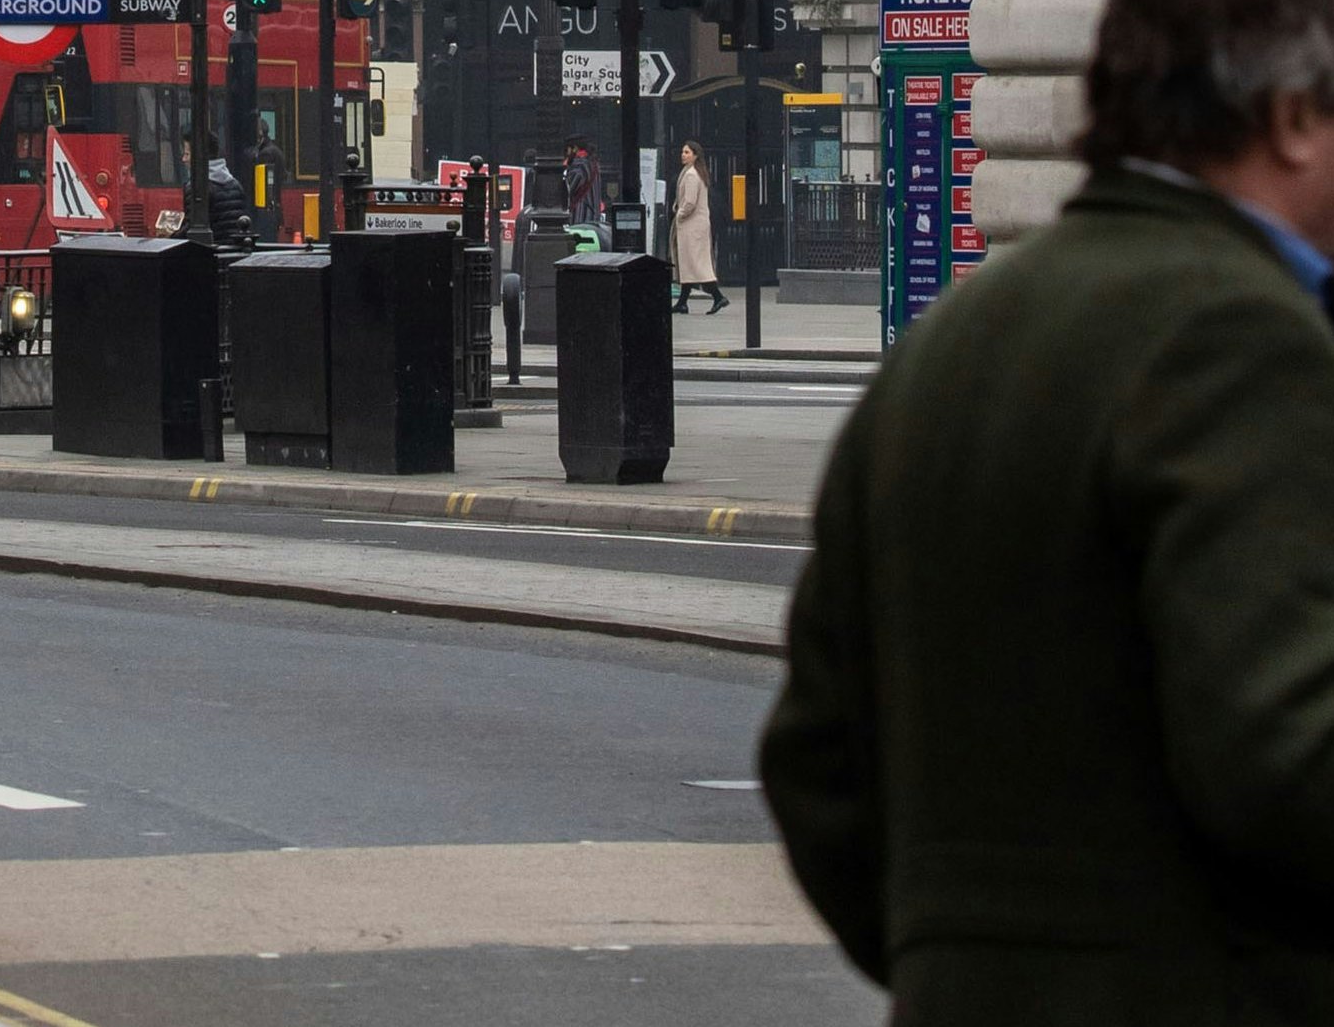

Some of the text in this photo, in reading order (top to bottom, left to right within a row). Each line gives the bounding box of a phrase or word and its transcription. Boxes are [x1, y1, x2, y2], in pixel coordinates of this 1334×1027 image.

[892, 17, 970, 38] ON SALE HER
[564, 55, 590, 67] City
[563, 68, 622, 80] algar Squ
[573, 82, 601, 92] Park
[375, 217, 423, 229] Bakerloo line
